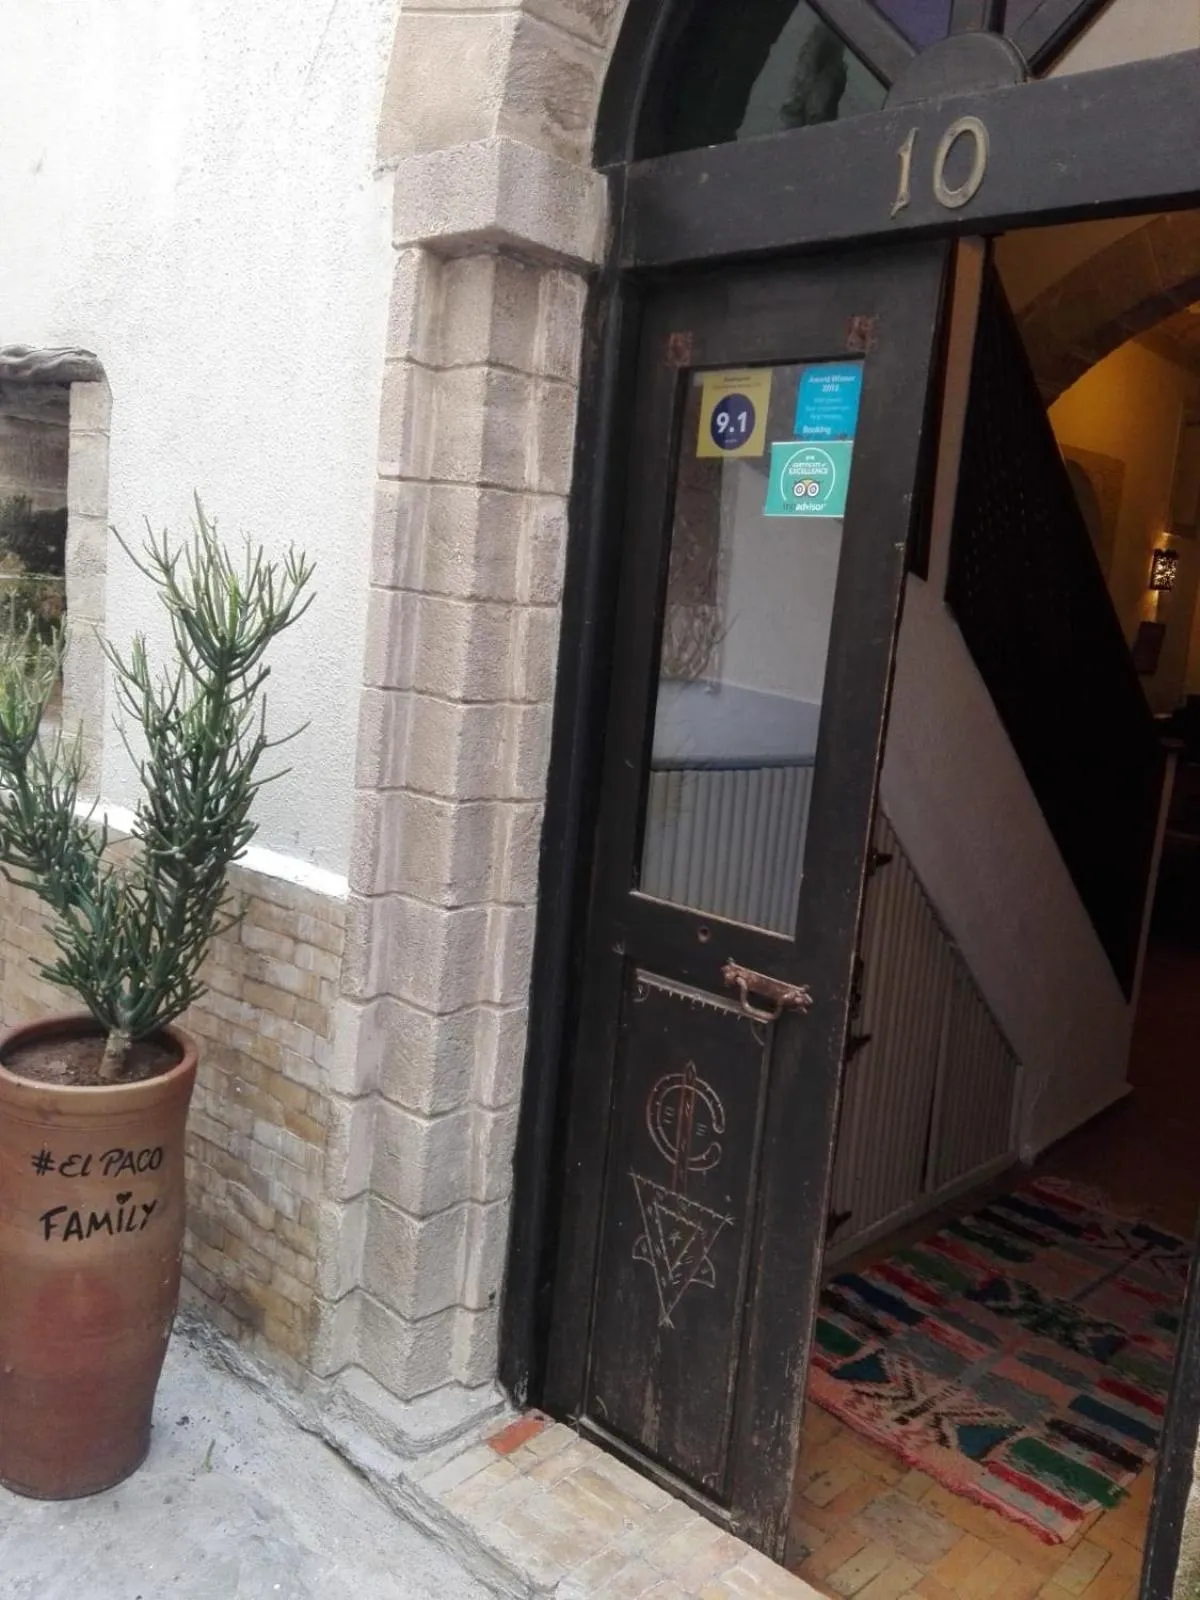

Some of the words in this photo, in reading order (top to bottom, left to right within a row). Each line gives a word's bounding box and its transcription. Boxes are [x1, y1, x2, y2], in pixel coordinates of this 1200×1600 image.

[890, 116, 989, 219] 10
[716, 411, 748, 434] 9.1
[788, 467, 829, 475] EXCELLENCE
[100, 1147, 163, 1178] PACO
